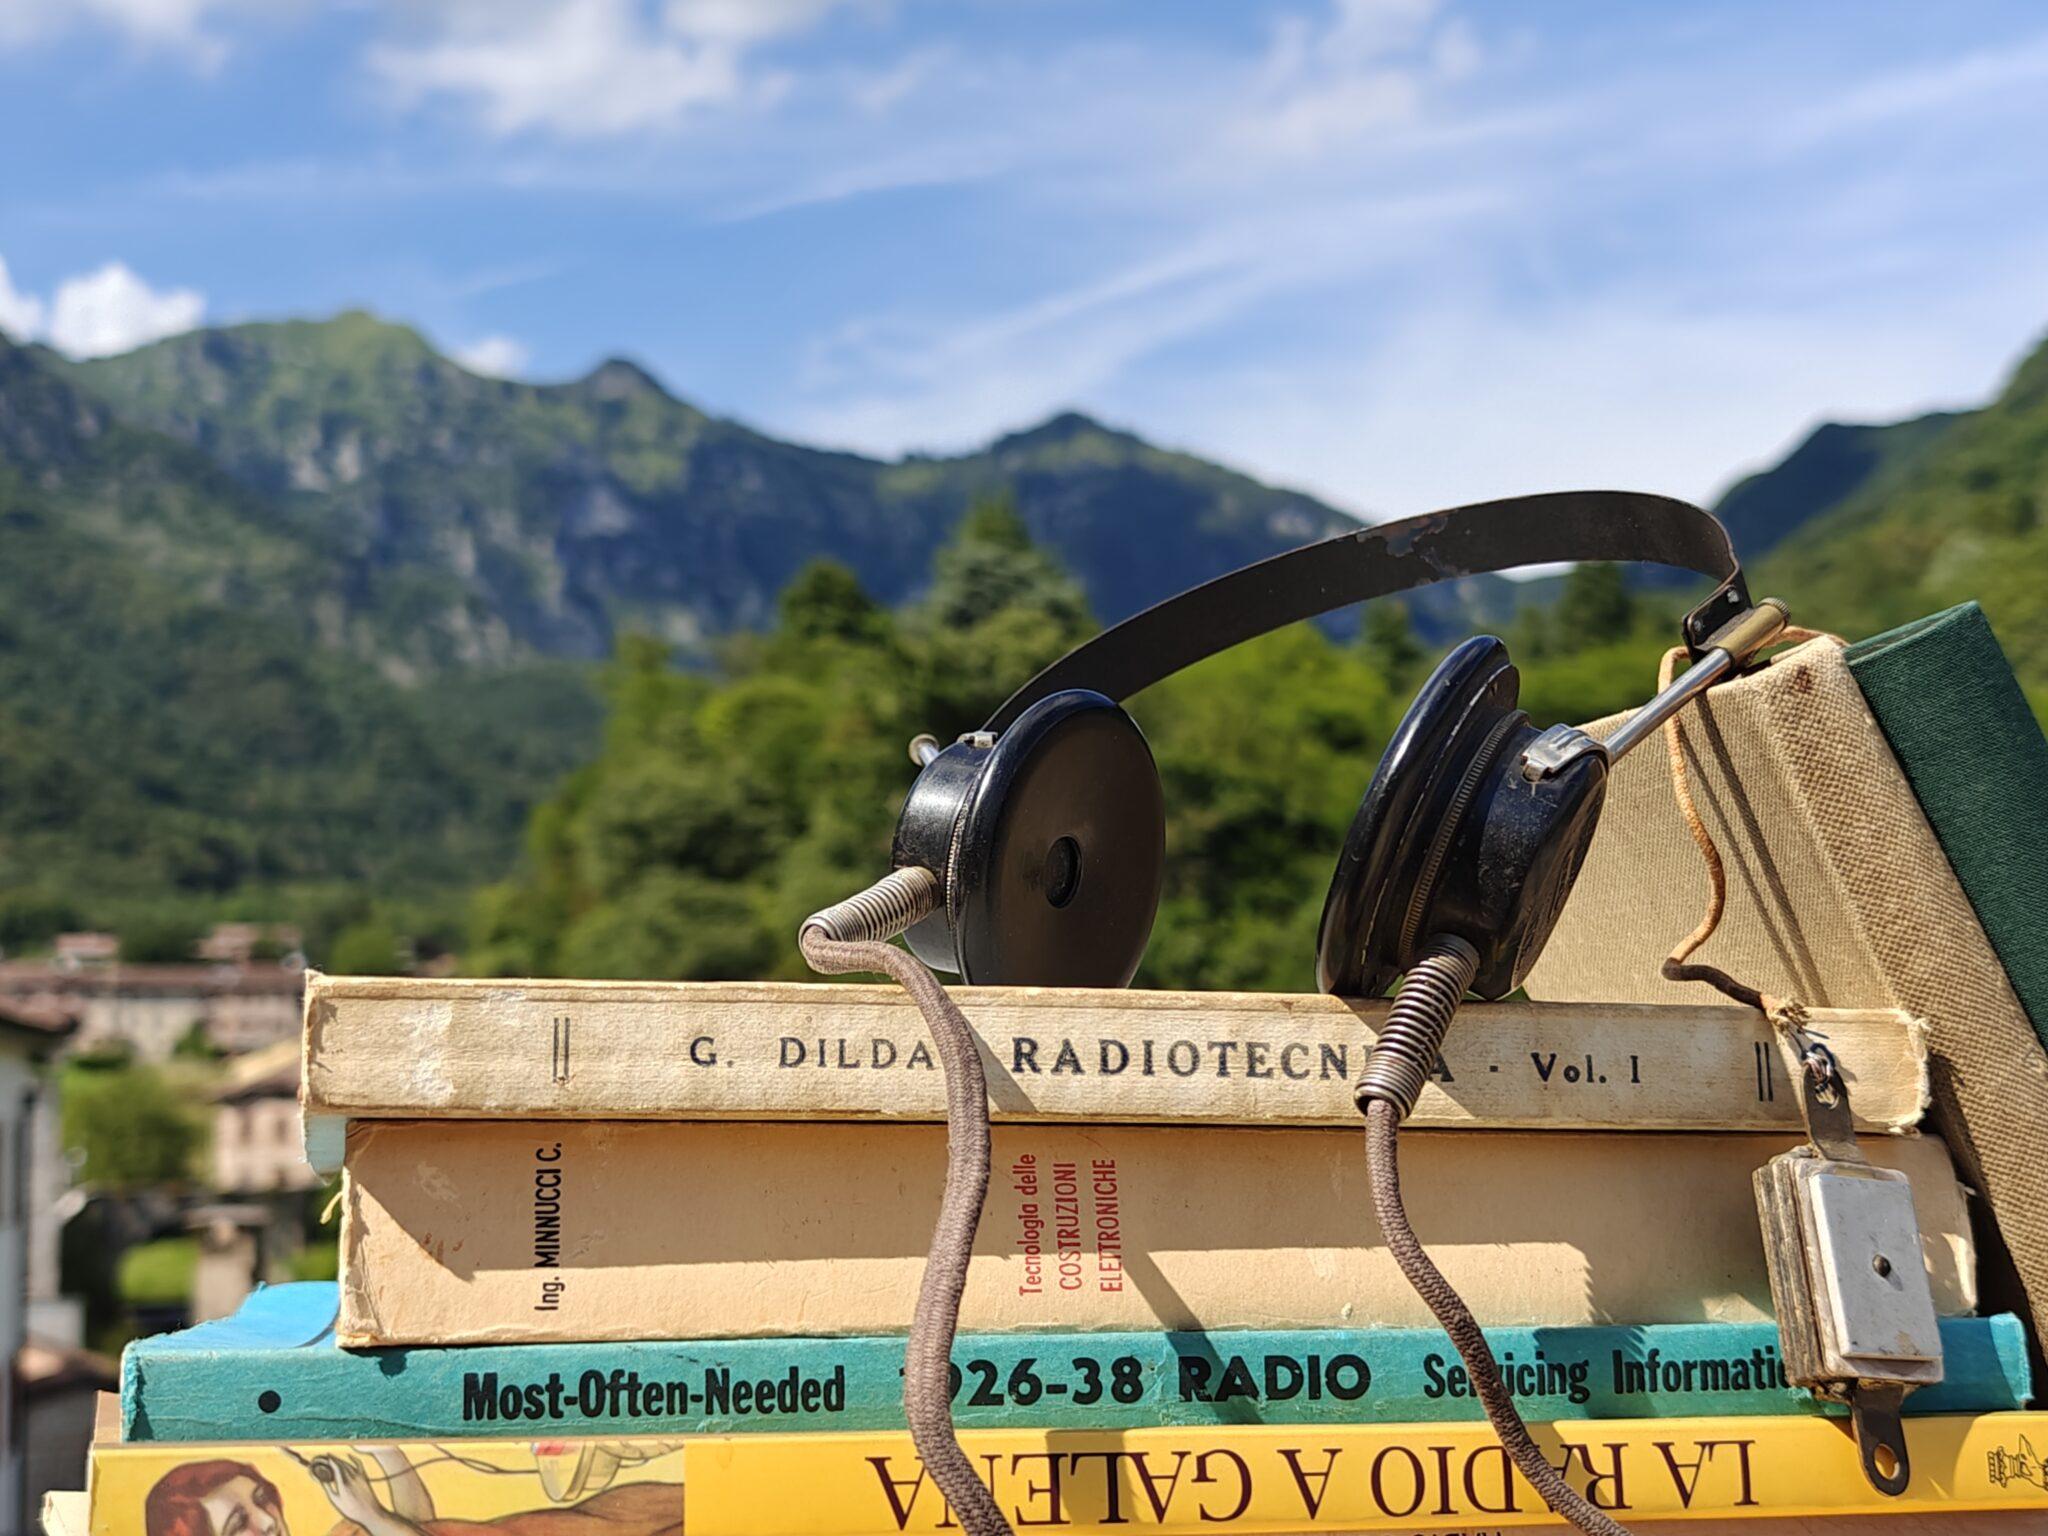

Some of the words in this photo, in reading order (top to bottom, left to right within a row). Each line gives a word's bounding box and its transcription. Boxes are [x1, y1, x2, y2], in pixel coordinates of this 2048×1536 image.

[690, 1036, 734, 1068] G.
[779, 1036, 935, 1070] DILDA
[1012, 1038, 1455, 1082] RADIOTECNA
[1531, 1052, 1607, 1083] Vol.
[535, 1142, 562, 1162] C.
[1012, 1154, 1038, 1195] delle
[534, 1168, 562, 1268] MINNUCCI
[1016, 1203, 1044, 1297] Tecnologia
[1053, 1162, 1082, 1291] COSTRUZIONI
[1092, 1159, 1123, 1292] ELETTRONICHE
[534, 1276, 565, 1311] Ing.
[462, 1365, 846, 1421] Most-Often-Needed
[899, 1355, 1144, 1406] 26-38
[1178, 1353, 1372, 1402] RADIO
[1611, 1344, 1792, 1394] Informati
[1279, 1448, 1344, 1521] A
[1652, 1439, 1760, 1509] LA
